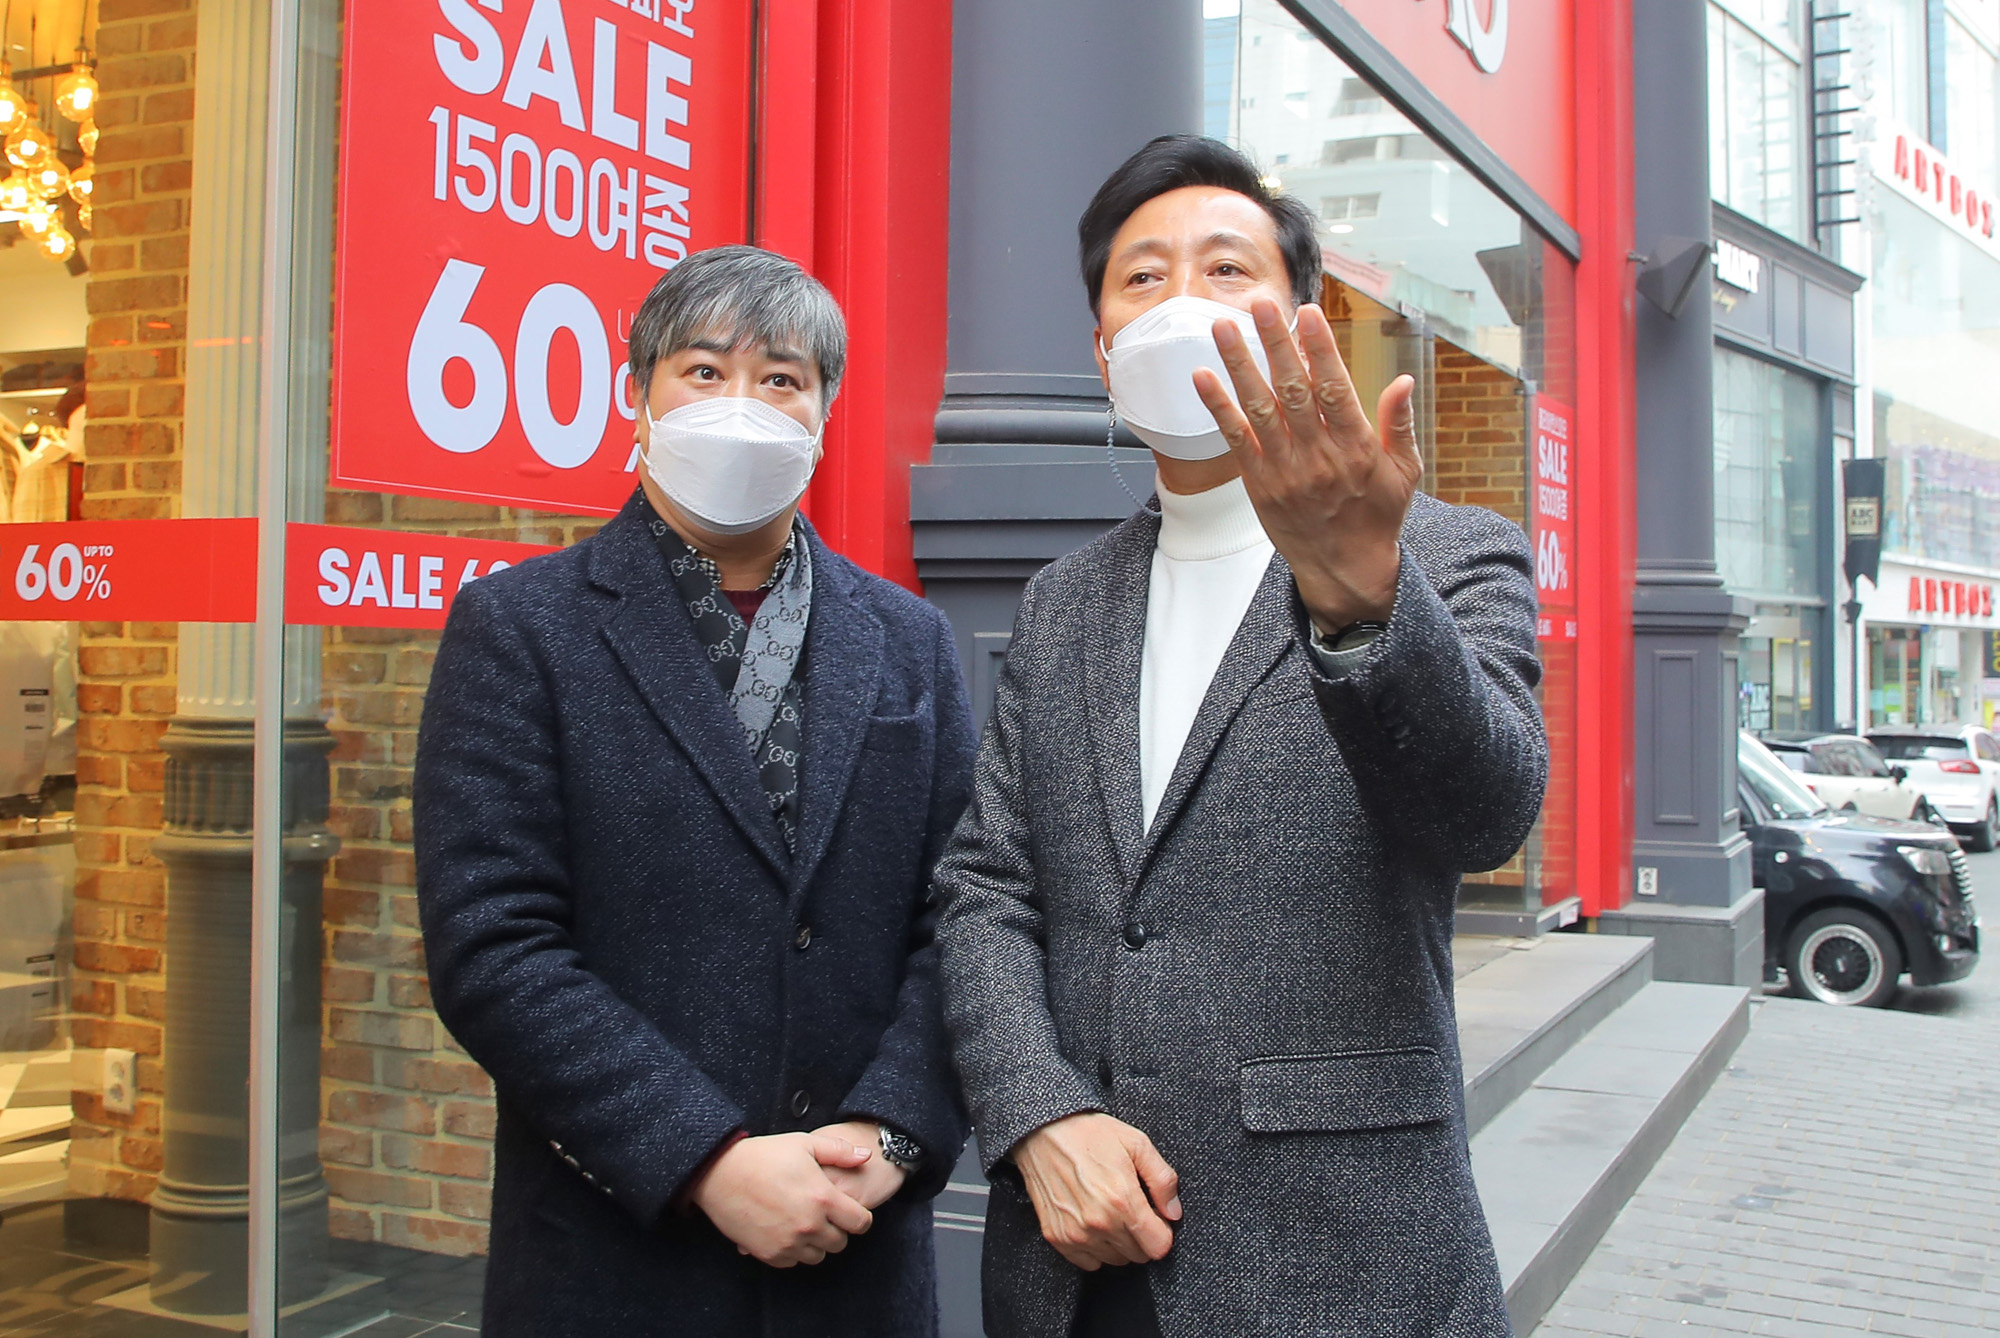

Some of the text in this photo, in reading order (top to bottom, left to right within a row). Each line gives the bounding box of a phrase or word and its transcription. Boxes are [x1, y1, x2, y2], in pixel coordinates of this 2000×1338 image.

[433, 0, 692, 170] SALE
[428, 105, 692, 270] 1500여종
[1894, 134, 1993, 239] ARTBOX
[1538, 434, 1568, 486] SALE
[15, 542, 111, 602] 60%
[317, 547, 445, 610] SALE
[1908, 576, 1993, 617] ARTBOX
